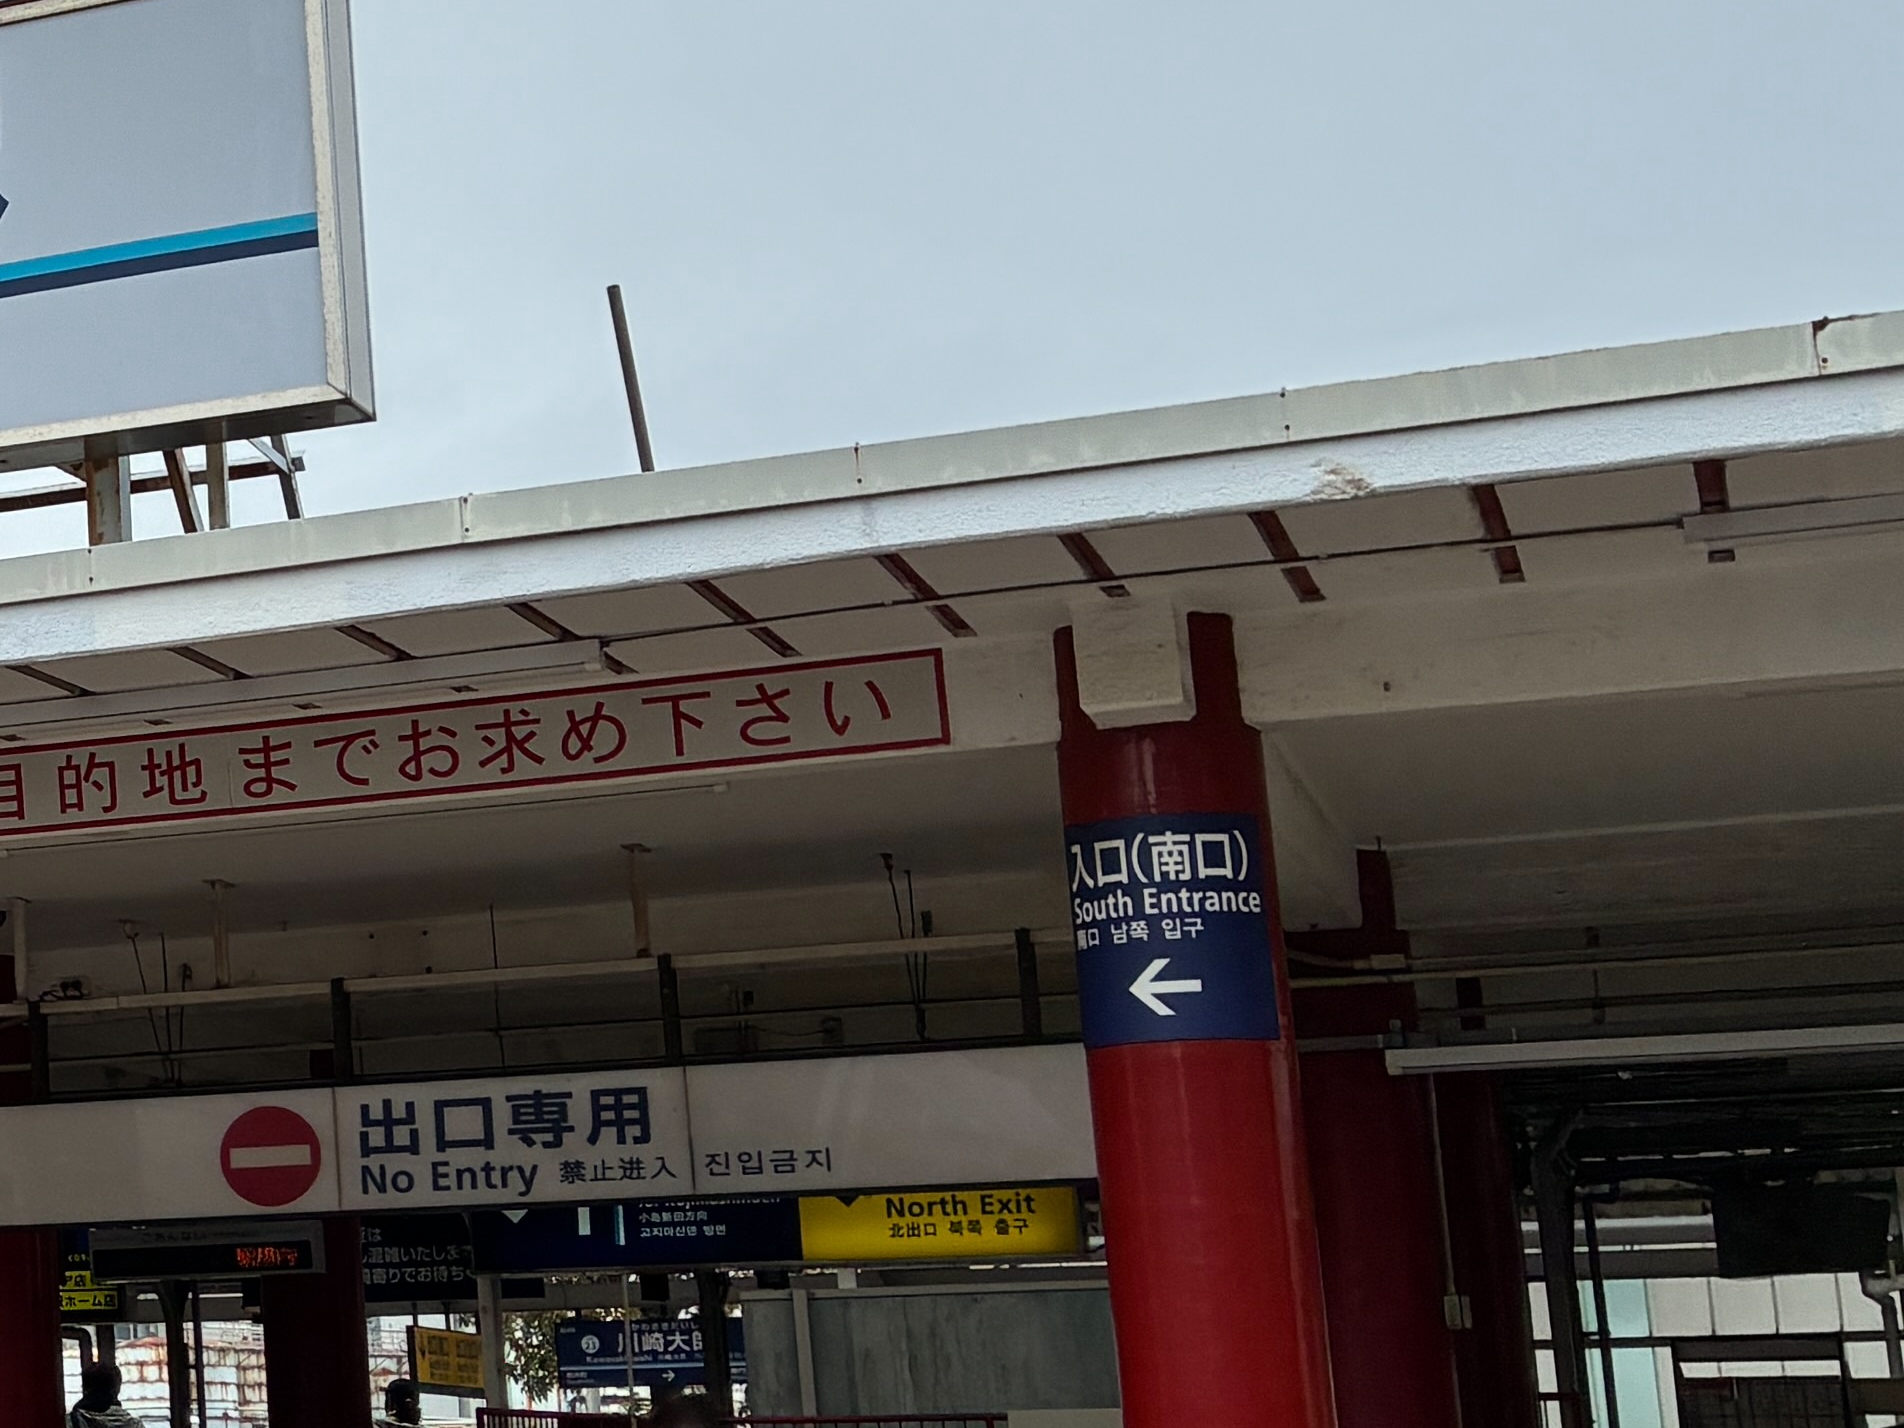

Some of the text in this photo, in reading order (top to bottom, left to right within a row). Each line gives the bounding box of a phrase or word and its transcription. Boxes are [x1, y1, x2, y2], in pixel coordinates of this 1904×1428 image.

[1074, 887, 1261, 924] South Entrance
[1161, 918, 1204, 940] 입구
[359, 1086, 652, 1158] 出口専用
[360, 1163, 415, 1195] No
[431, 1160, 538, 1197] Entry
[705, 1147, 832, 1177] 진입금지
[886, 1192, 1036, 1218] North Exit
[889, 1222, 937, 1238] 北出口
[60, 1294, 116, 1308] ホーム店
